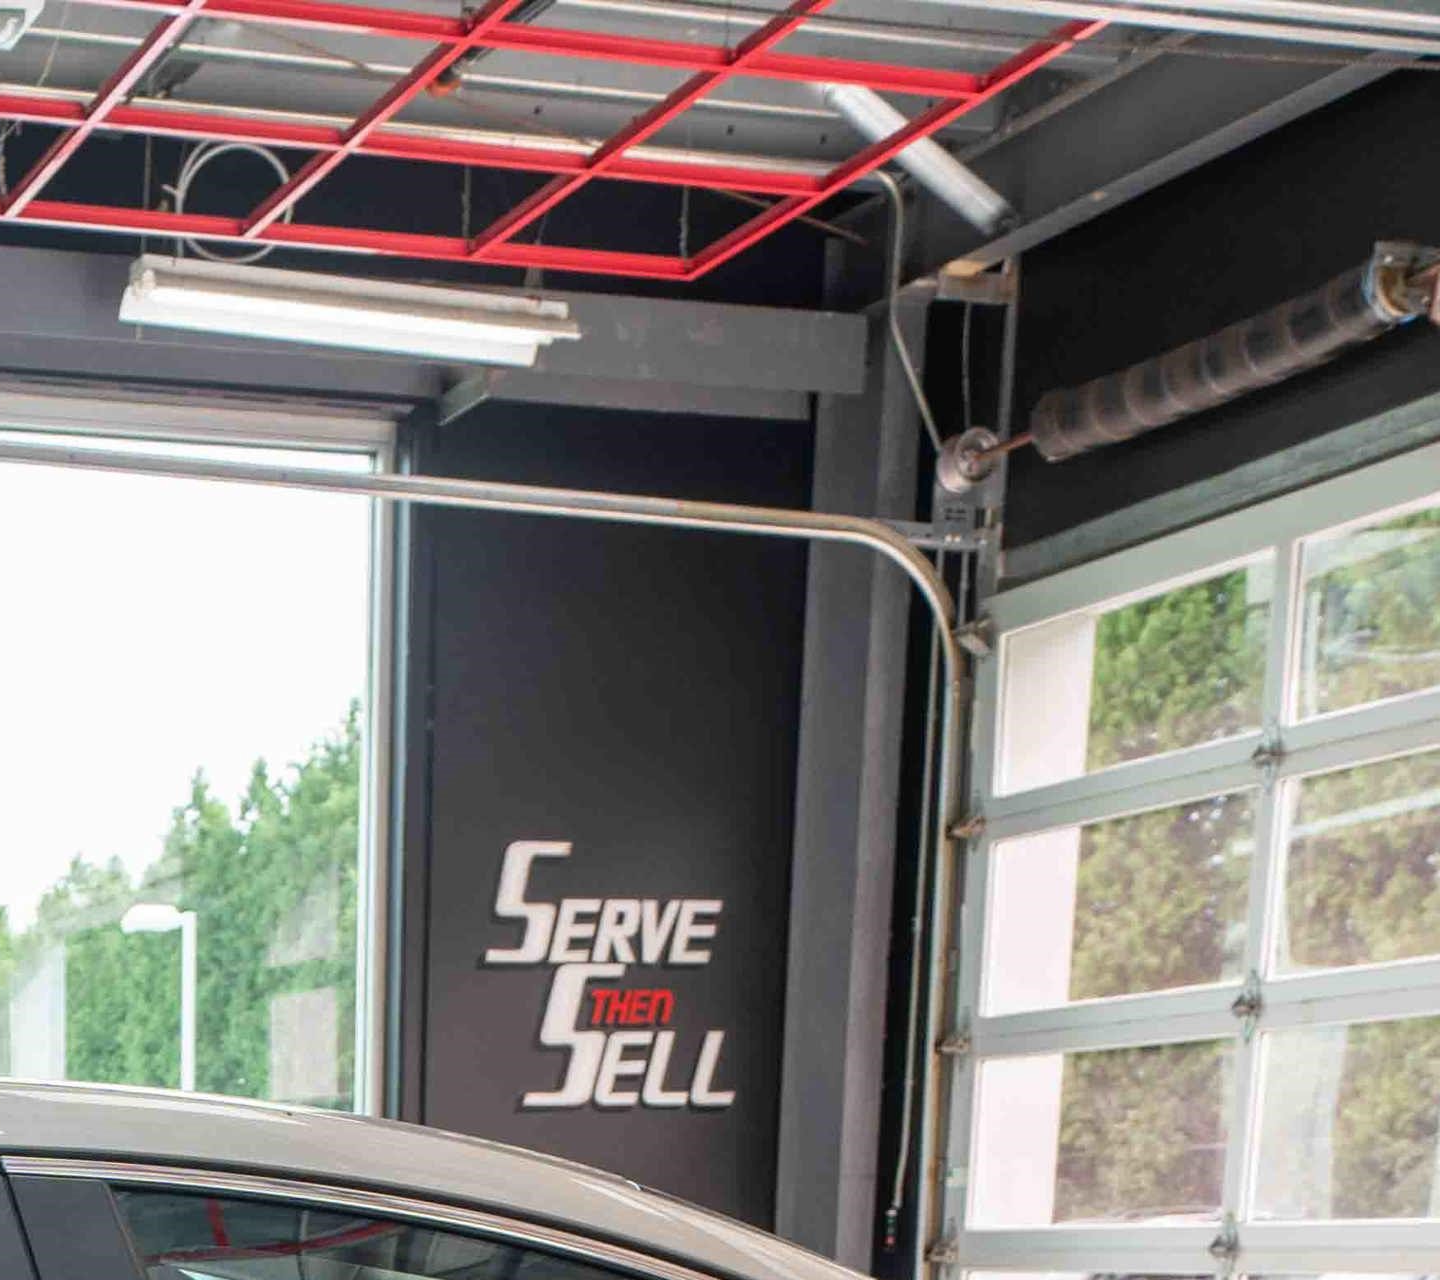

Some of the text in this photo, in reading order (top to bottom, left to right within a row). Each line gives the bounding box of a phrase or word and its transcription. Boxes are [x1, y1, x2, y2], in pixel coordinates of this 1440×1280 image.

[485, 840, 722, 963] SERVE
[523, 963, 736, 1107] SELL
[590, 989, 674, 1024] THEN
